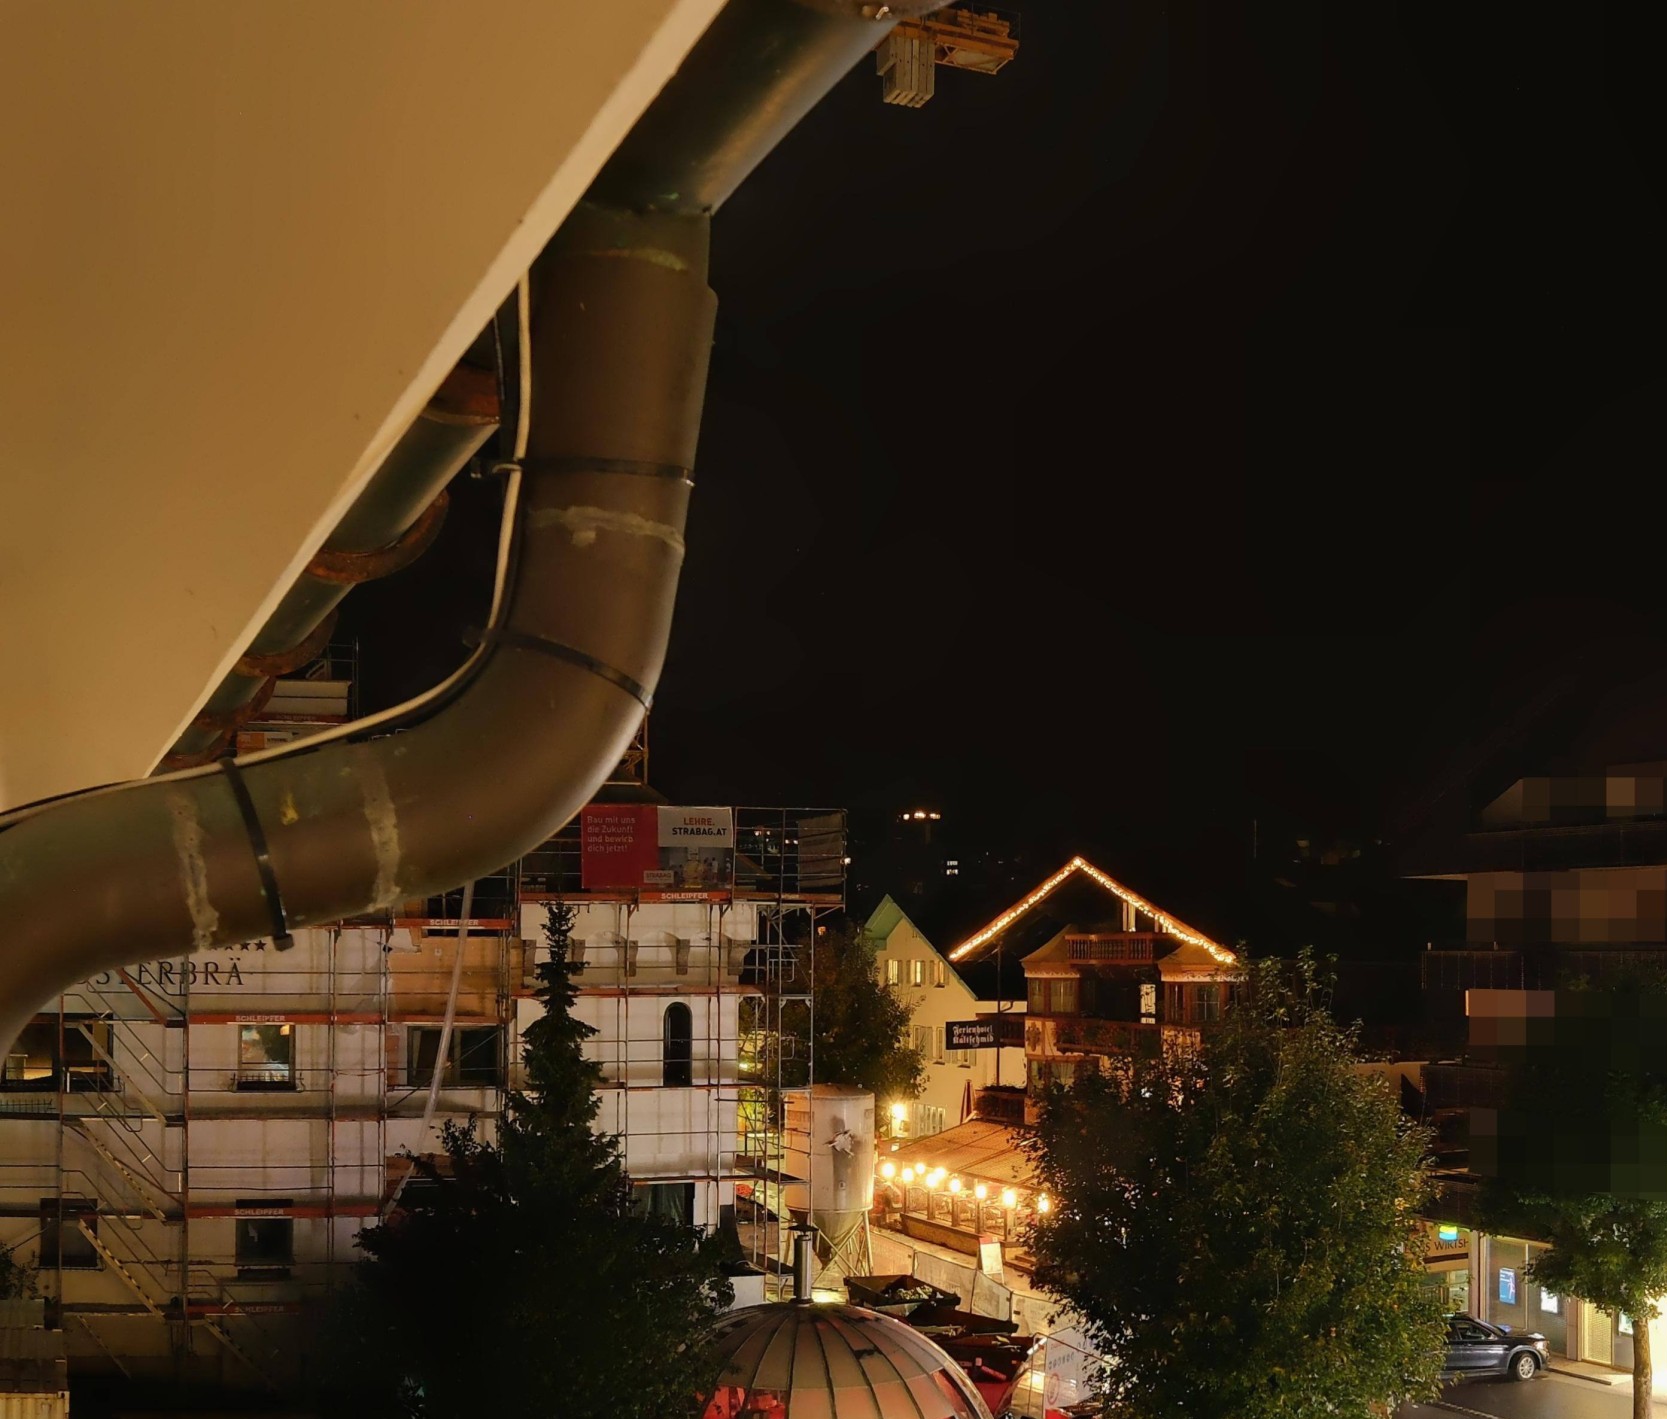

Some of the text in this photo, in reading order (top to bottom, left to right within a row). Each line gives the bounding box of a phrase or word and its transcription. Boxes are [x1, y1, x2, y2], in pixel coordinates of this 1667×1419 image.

[587, 816, 600, 824] Bau
[683, 817, 715, 826] LEHRE.
[587, 825, 633, 834] die Zukunft
[672, 828, 727, 836] STRABAG.AT
[587, 835, 601, 843] und
[587, 844, 604, 852] dich
[234, 1208, 284, 1216] SCHLEIPFER
